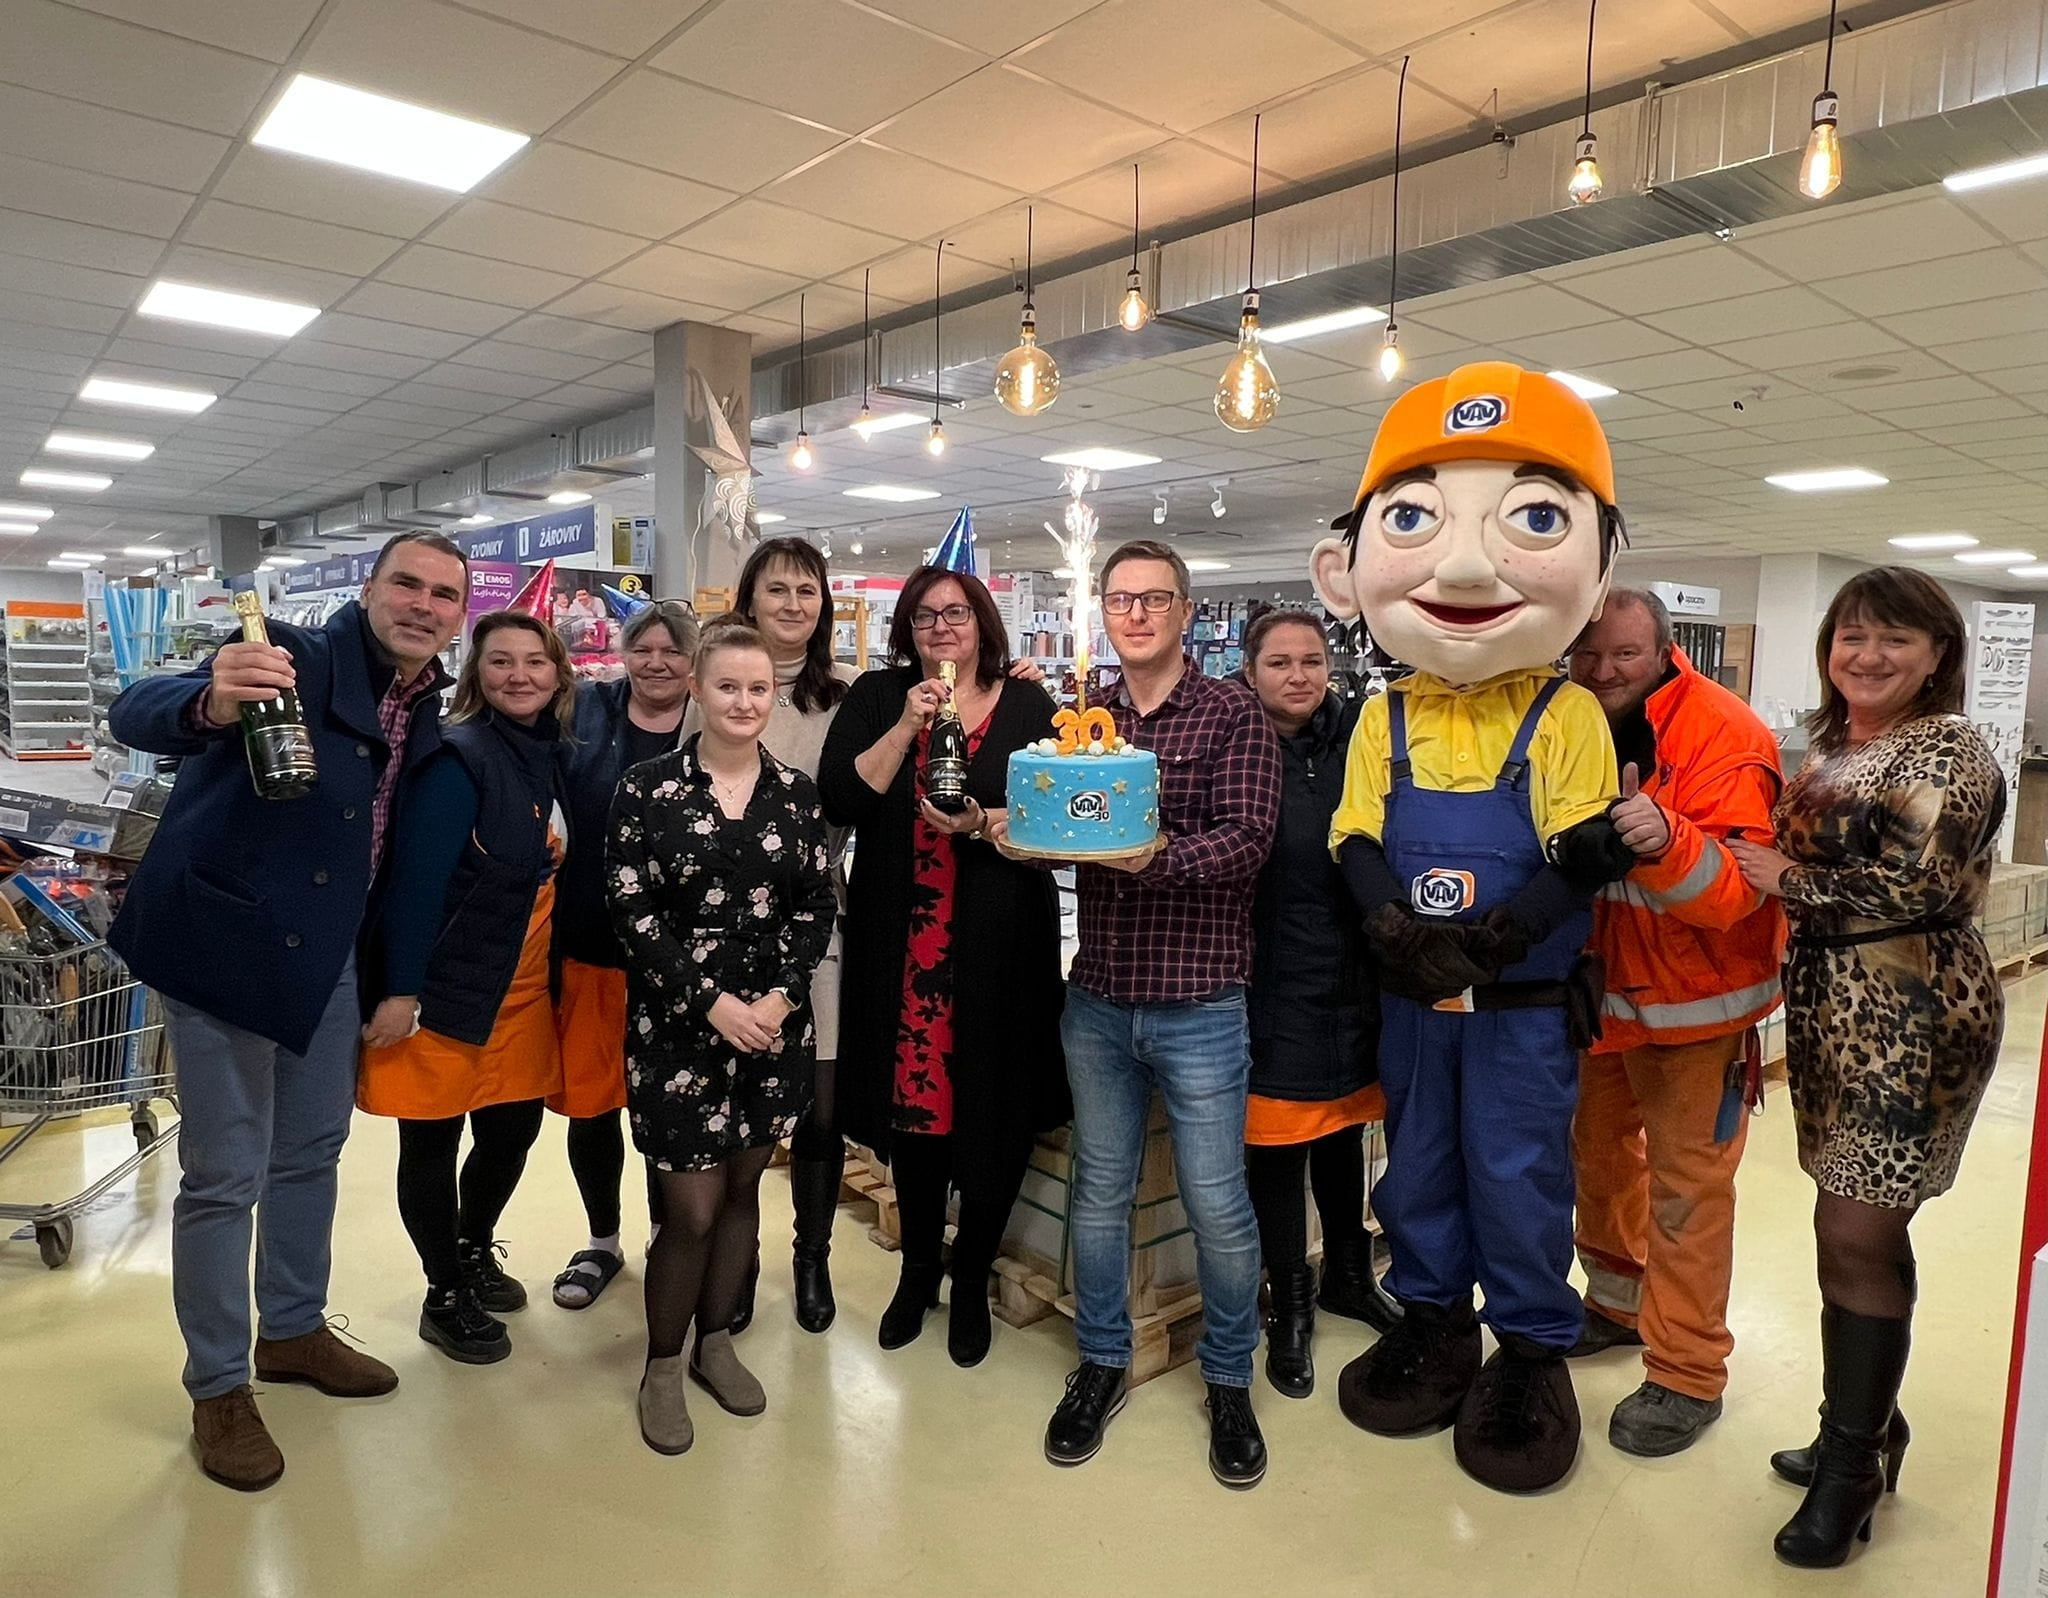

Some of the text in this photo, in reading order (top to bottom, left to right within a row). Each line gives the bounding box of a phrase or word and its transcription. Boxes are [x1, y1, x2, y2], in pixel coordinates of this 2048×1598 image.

[1458, 402, 1496, 421] VAV
[539, 523, 582, 548] ŽÁROVKY
[470, 539, 504, 559] ZVONKY
[485, 575, 511, 584] EMOS
[625, 579, 636, 593] 3
[473, 587, 511, 600] lighting
[1051, 706, 1117, 755] 30
[1423, 880, 1459, 904] VAV
